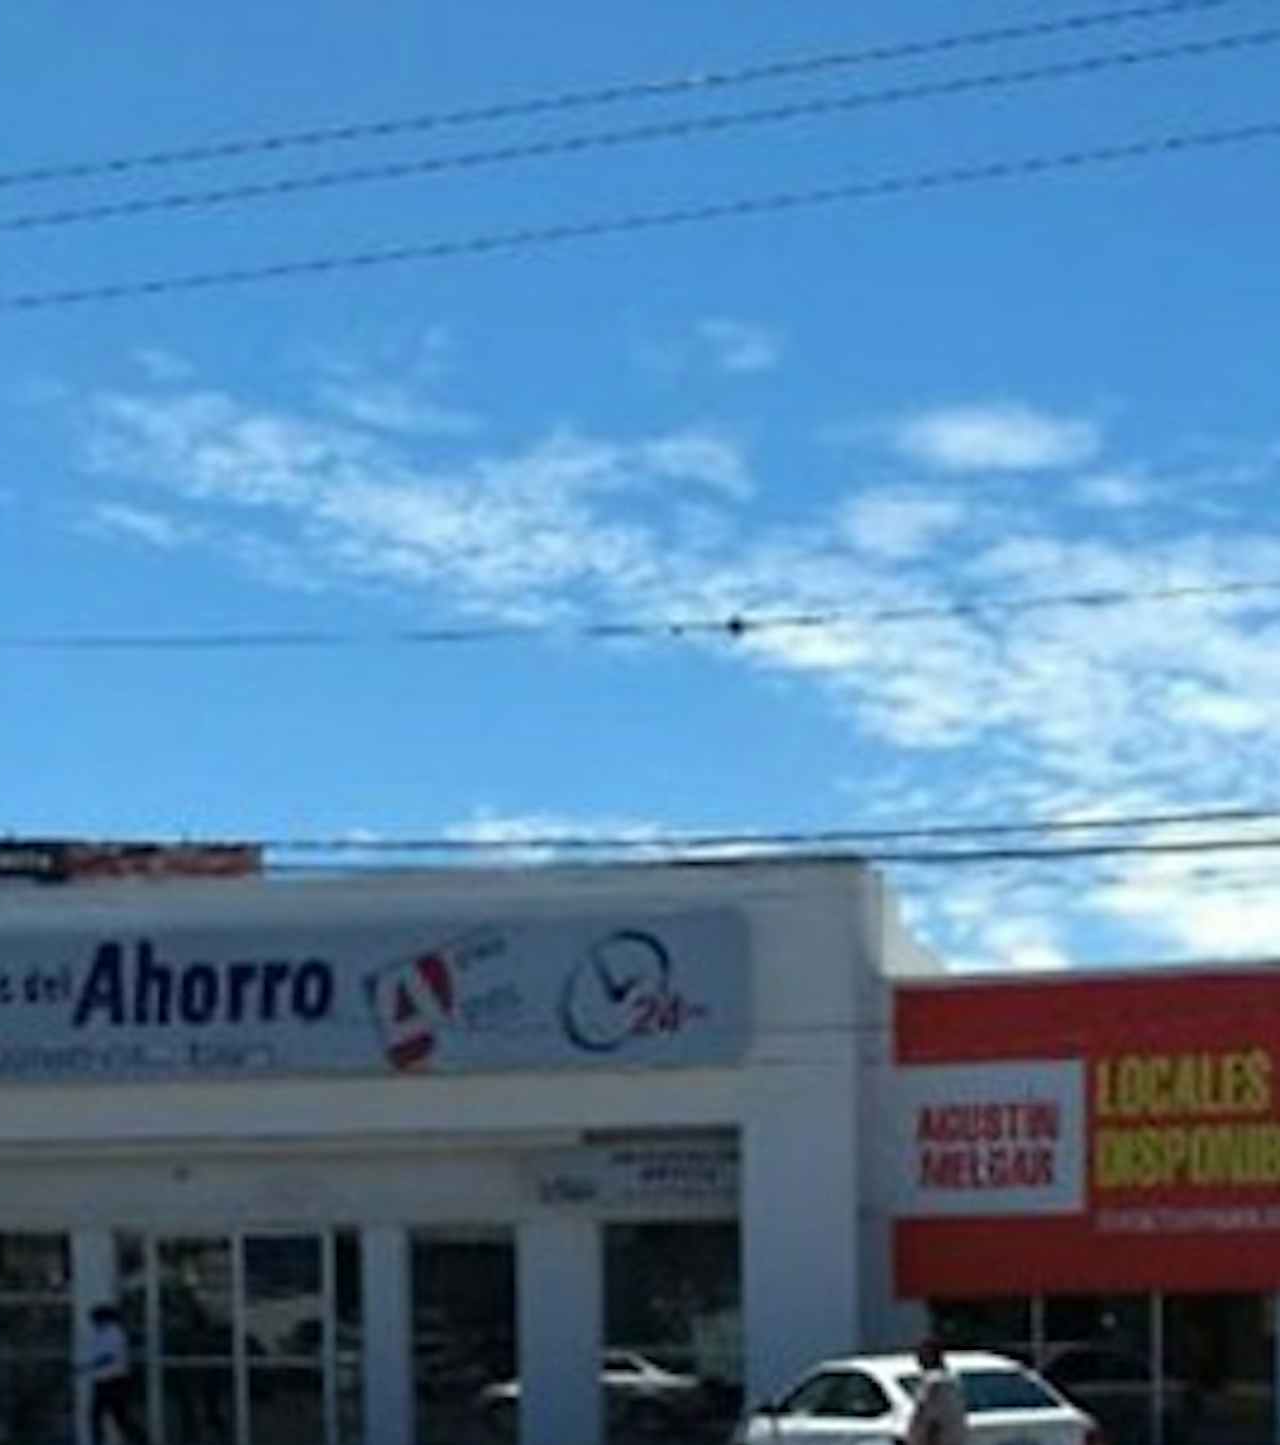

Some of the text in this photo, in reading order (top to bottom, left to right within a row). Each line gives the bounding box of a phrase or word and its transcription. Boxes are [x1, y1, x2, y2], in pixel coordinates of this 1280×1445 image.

[24, 963, 71, 1003] del
[73, 938, 334, 1030] Ahorro
[1096, 1049, 1271, 1117] LOCALES
